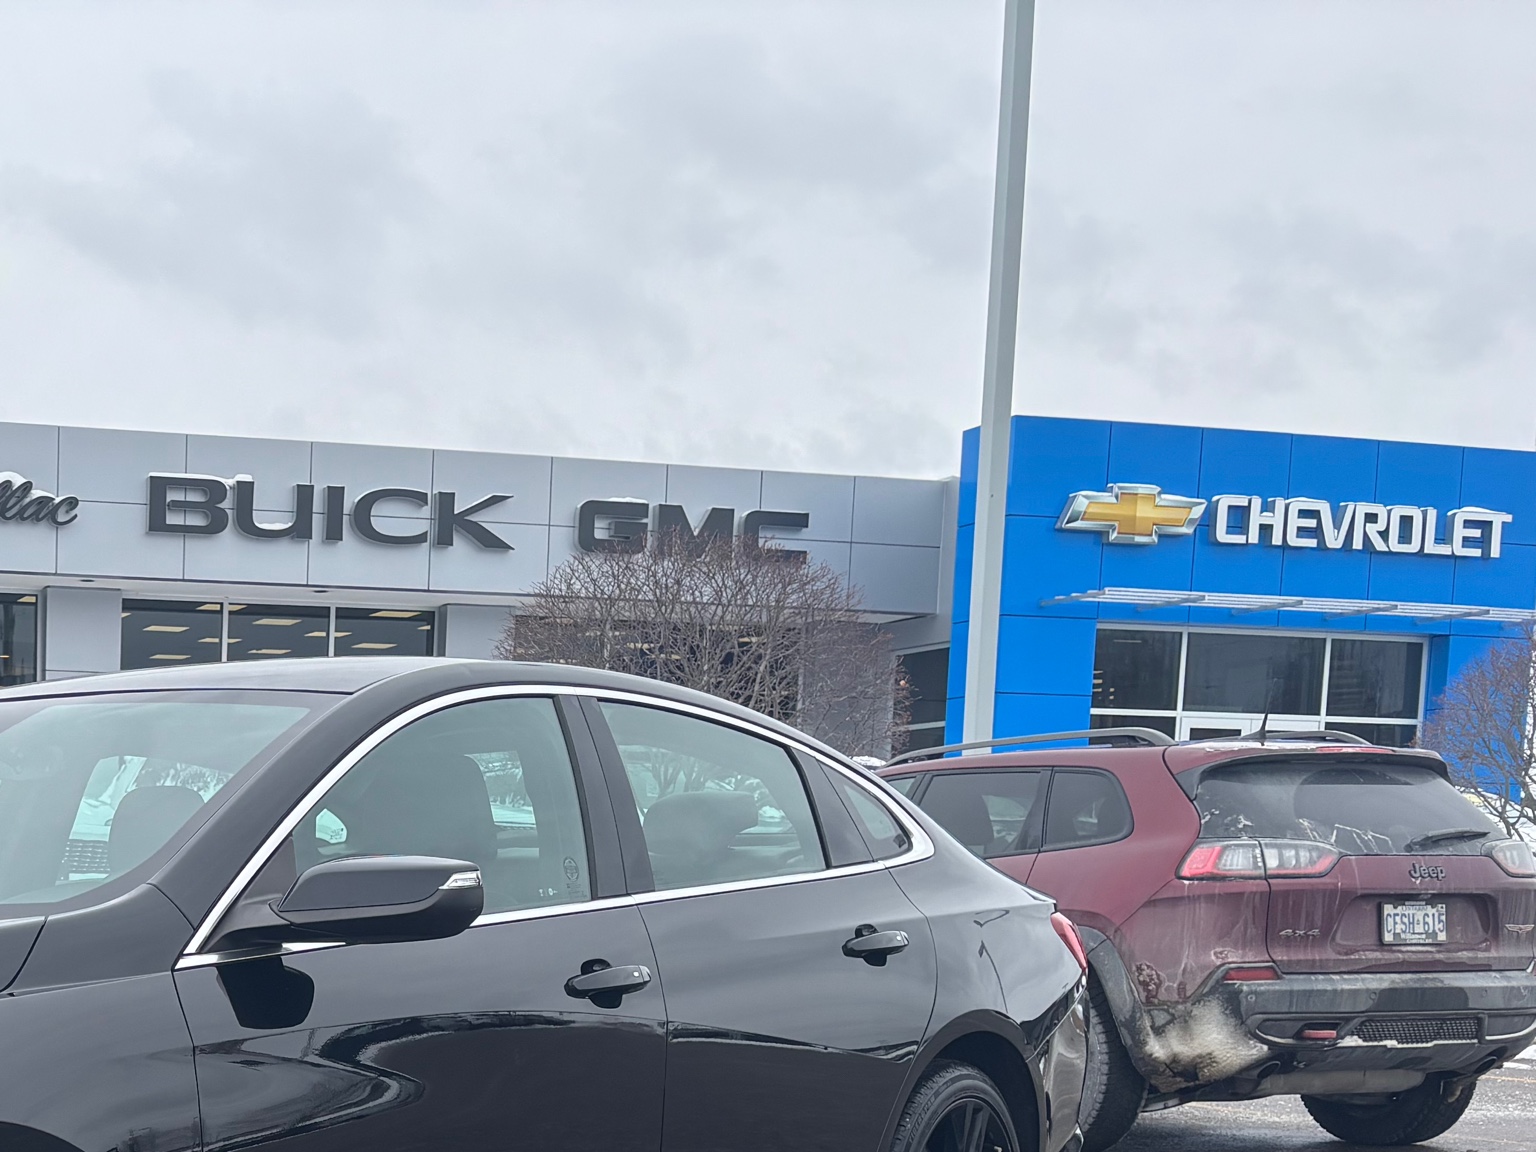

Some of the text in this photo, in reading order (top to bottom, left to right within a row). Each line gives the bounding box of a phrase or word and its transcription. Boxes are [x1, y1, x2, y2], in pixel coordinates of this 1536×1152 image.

[147, 475, 515, 551] BUICK
[574, 499, 810, 565] GMC
[1212, 494, 1513, 559] CHEVROLET
[1409, 863, 1446, 881] Jeep
[1423, 912, 1445, 933] 615
